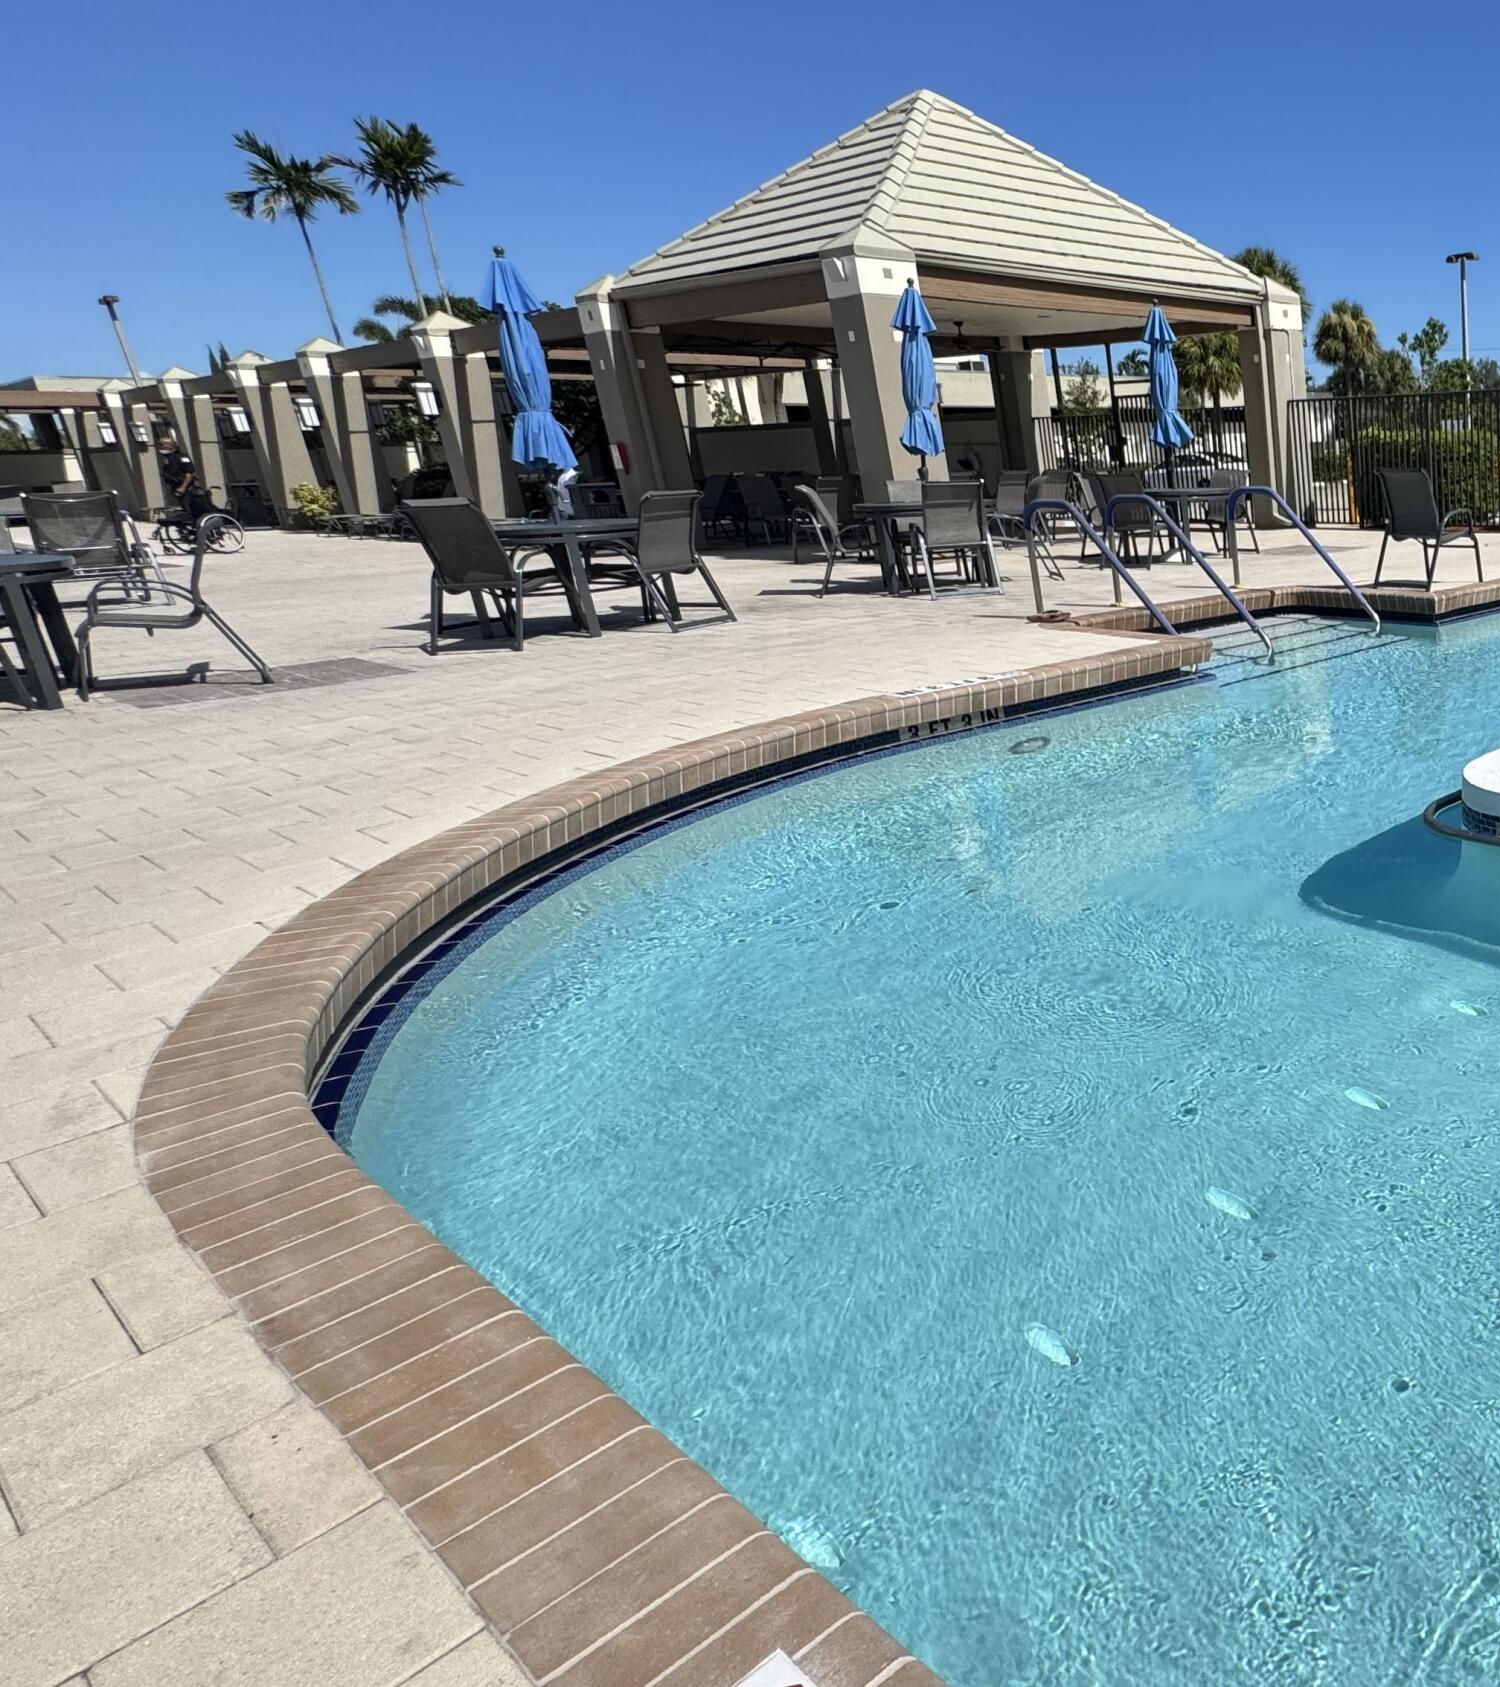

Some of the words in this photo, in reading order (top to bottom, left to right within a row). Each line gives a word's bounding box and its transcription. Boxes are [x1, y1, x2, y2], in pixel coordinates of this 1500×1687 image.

[907, 725, 919, 738] 3
[928, 718, 951, 734] FT
[981, 708, 999, 723] IN
